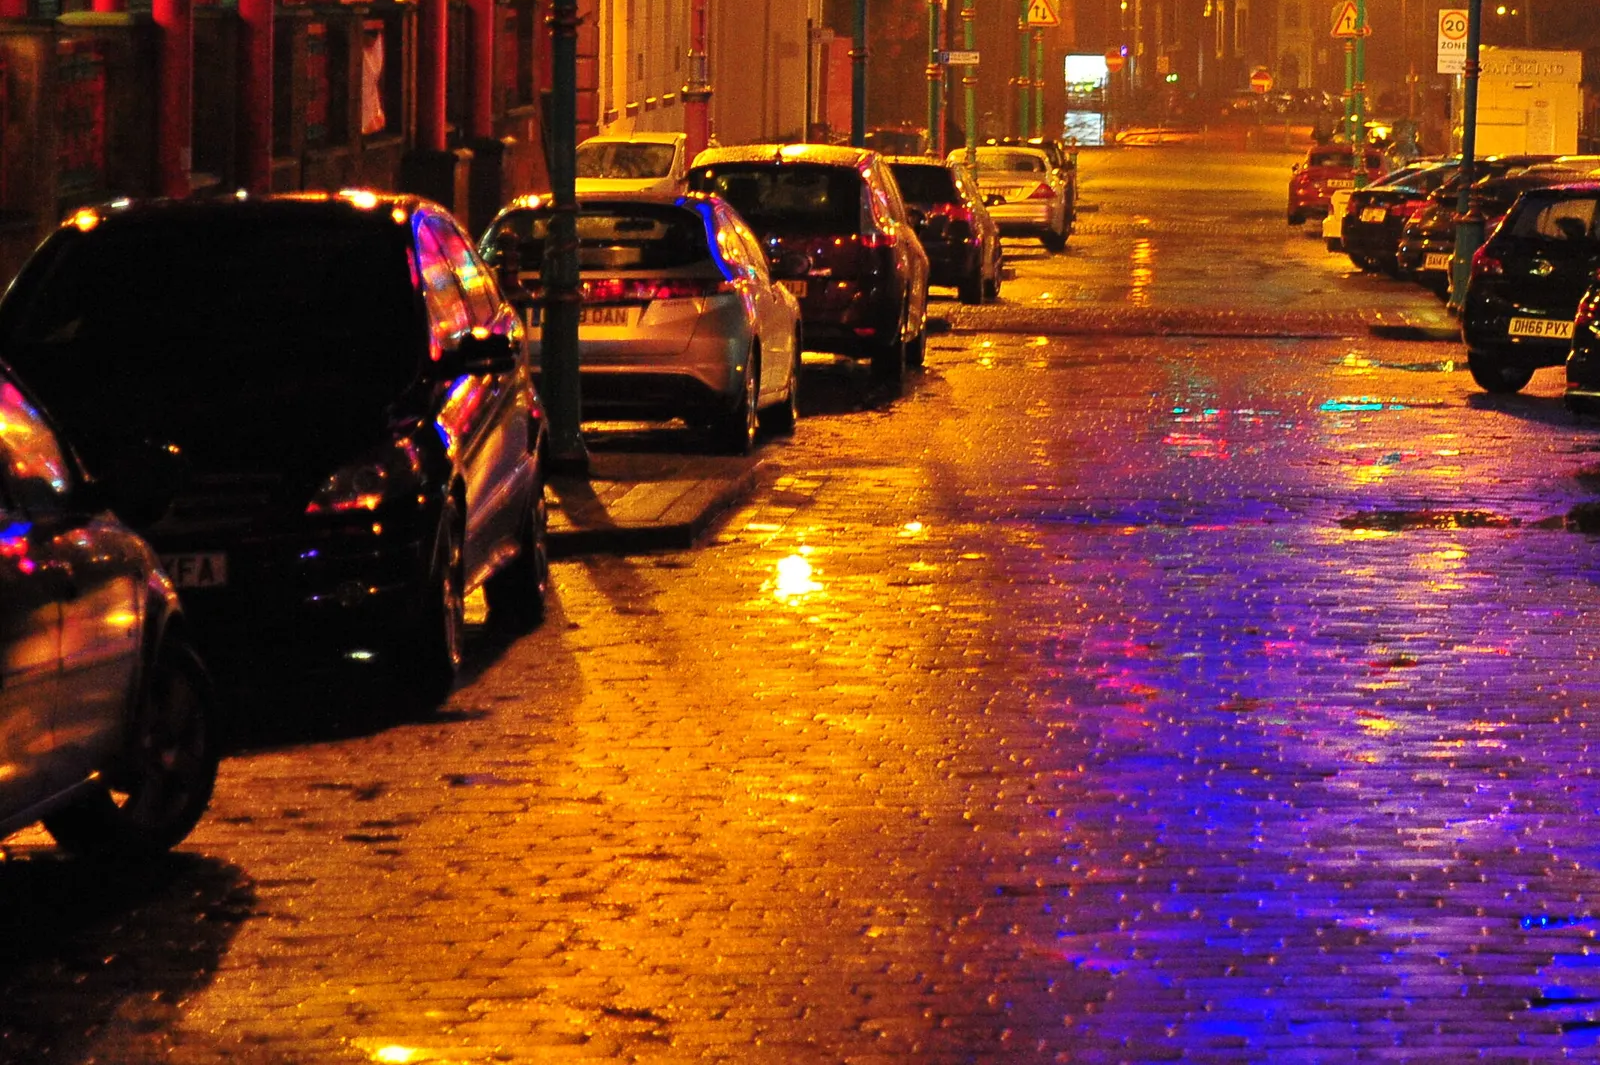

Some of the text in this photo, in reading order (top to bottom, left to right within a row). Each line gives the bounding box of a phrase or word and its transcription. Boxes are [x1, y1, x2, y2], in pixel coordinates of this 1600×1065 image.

[1445, 20, 1465, 33] 20
[1480, 62, 1565, 76] CATERING
[1513, 320, 1570, 337] DH66 PVX
